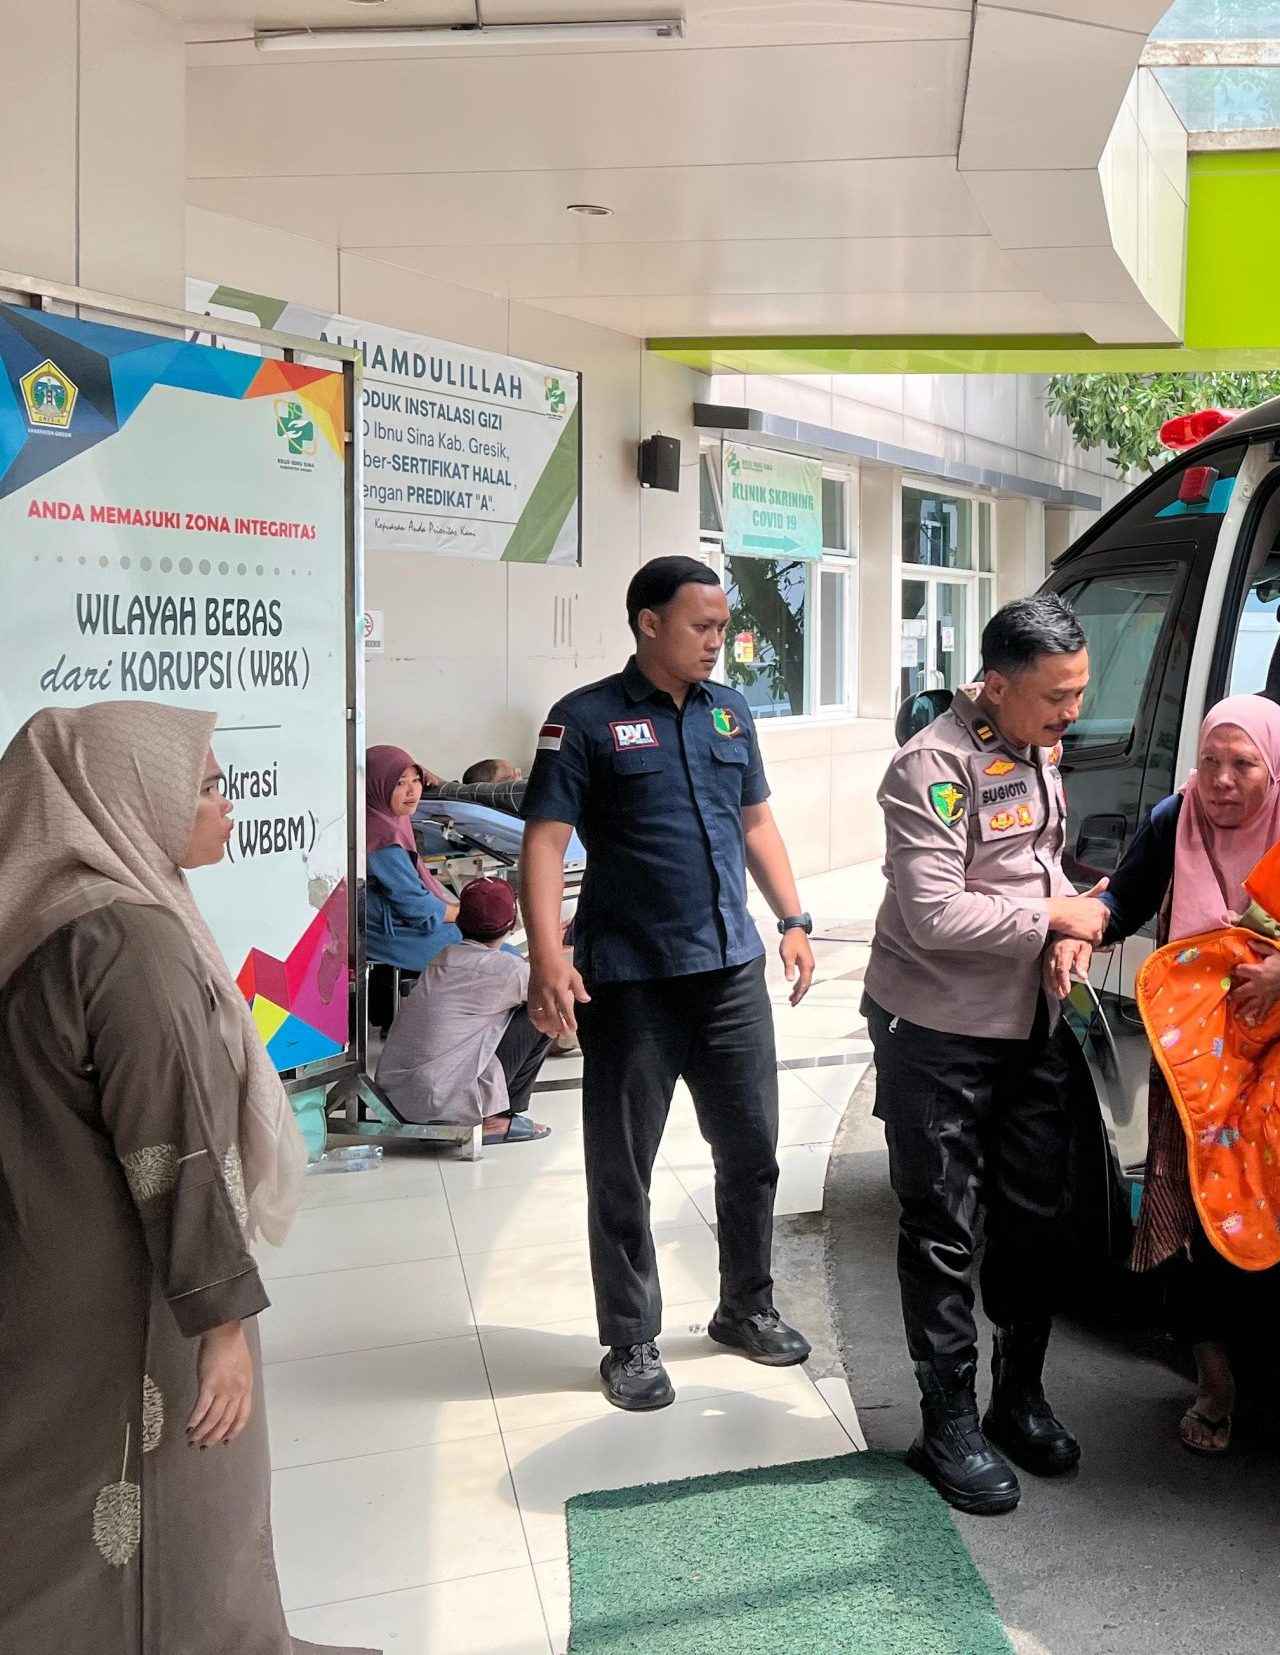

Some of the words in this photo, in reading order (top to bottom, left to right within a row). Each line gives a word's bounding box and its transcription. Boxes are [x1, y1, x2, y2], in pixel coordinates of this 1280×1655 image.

[405, 397, 475, 426] INSTALASI
[478, 411, 502, 431] GIZI
[374, 421, 403, 442] Ibnu
[407, 427, 435, 447] Sina
[439, 431, 465, 452] Kab.
[469, 437, 510, 461] Gresik,
[407, 485, 473, 509] PREDIKAT
[732, 482, 767, 503] KLINIK
[768, 487, 814, 511] SKRINING
[27, 499, 85, 522] ANDA
[90, 506, 181, 530] MEMASUKI
[185, 513, 231, 534] ZONA
[234, 517, 317, 540] INTEGRITAS
[752, 510, 784, 529] COVID
[786, 514, 797, 530] 19
[76, 593, 197, 636] WILAYAH
[205, 598, 283, 637] BEBAS
[39, 653, 113, 692] dari
[121, 650, 232, 692] KORUPSI
[238, 646, 310, 691] (WBK)
[982, 780, 1028, 804] SUGIOTO
